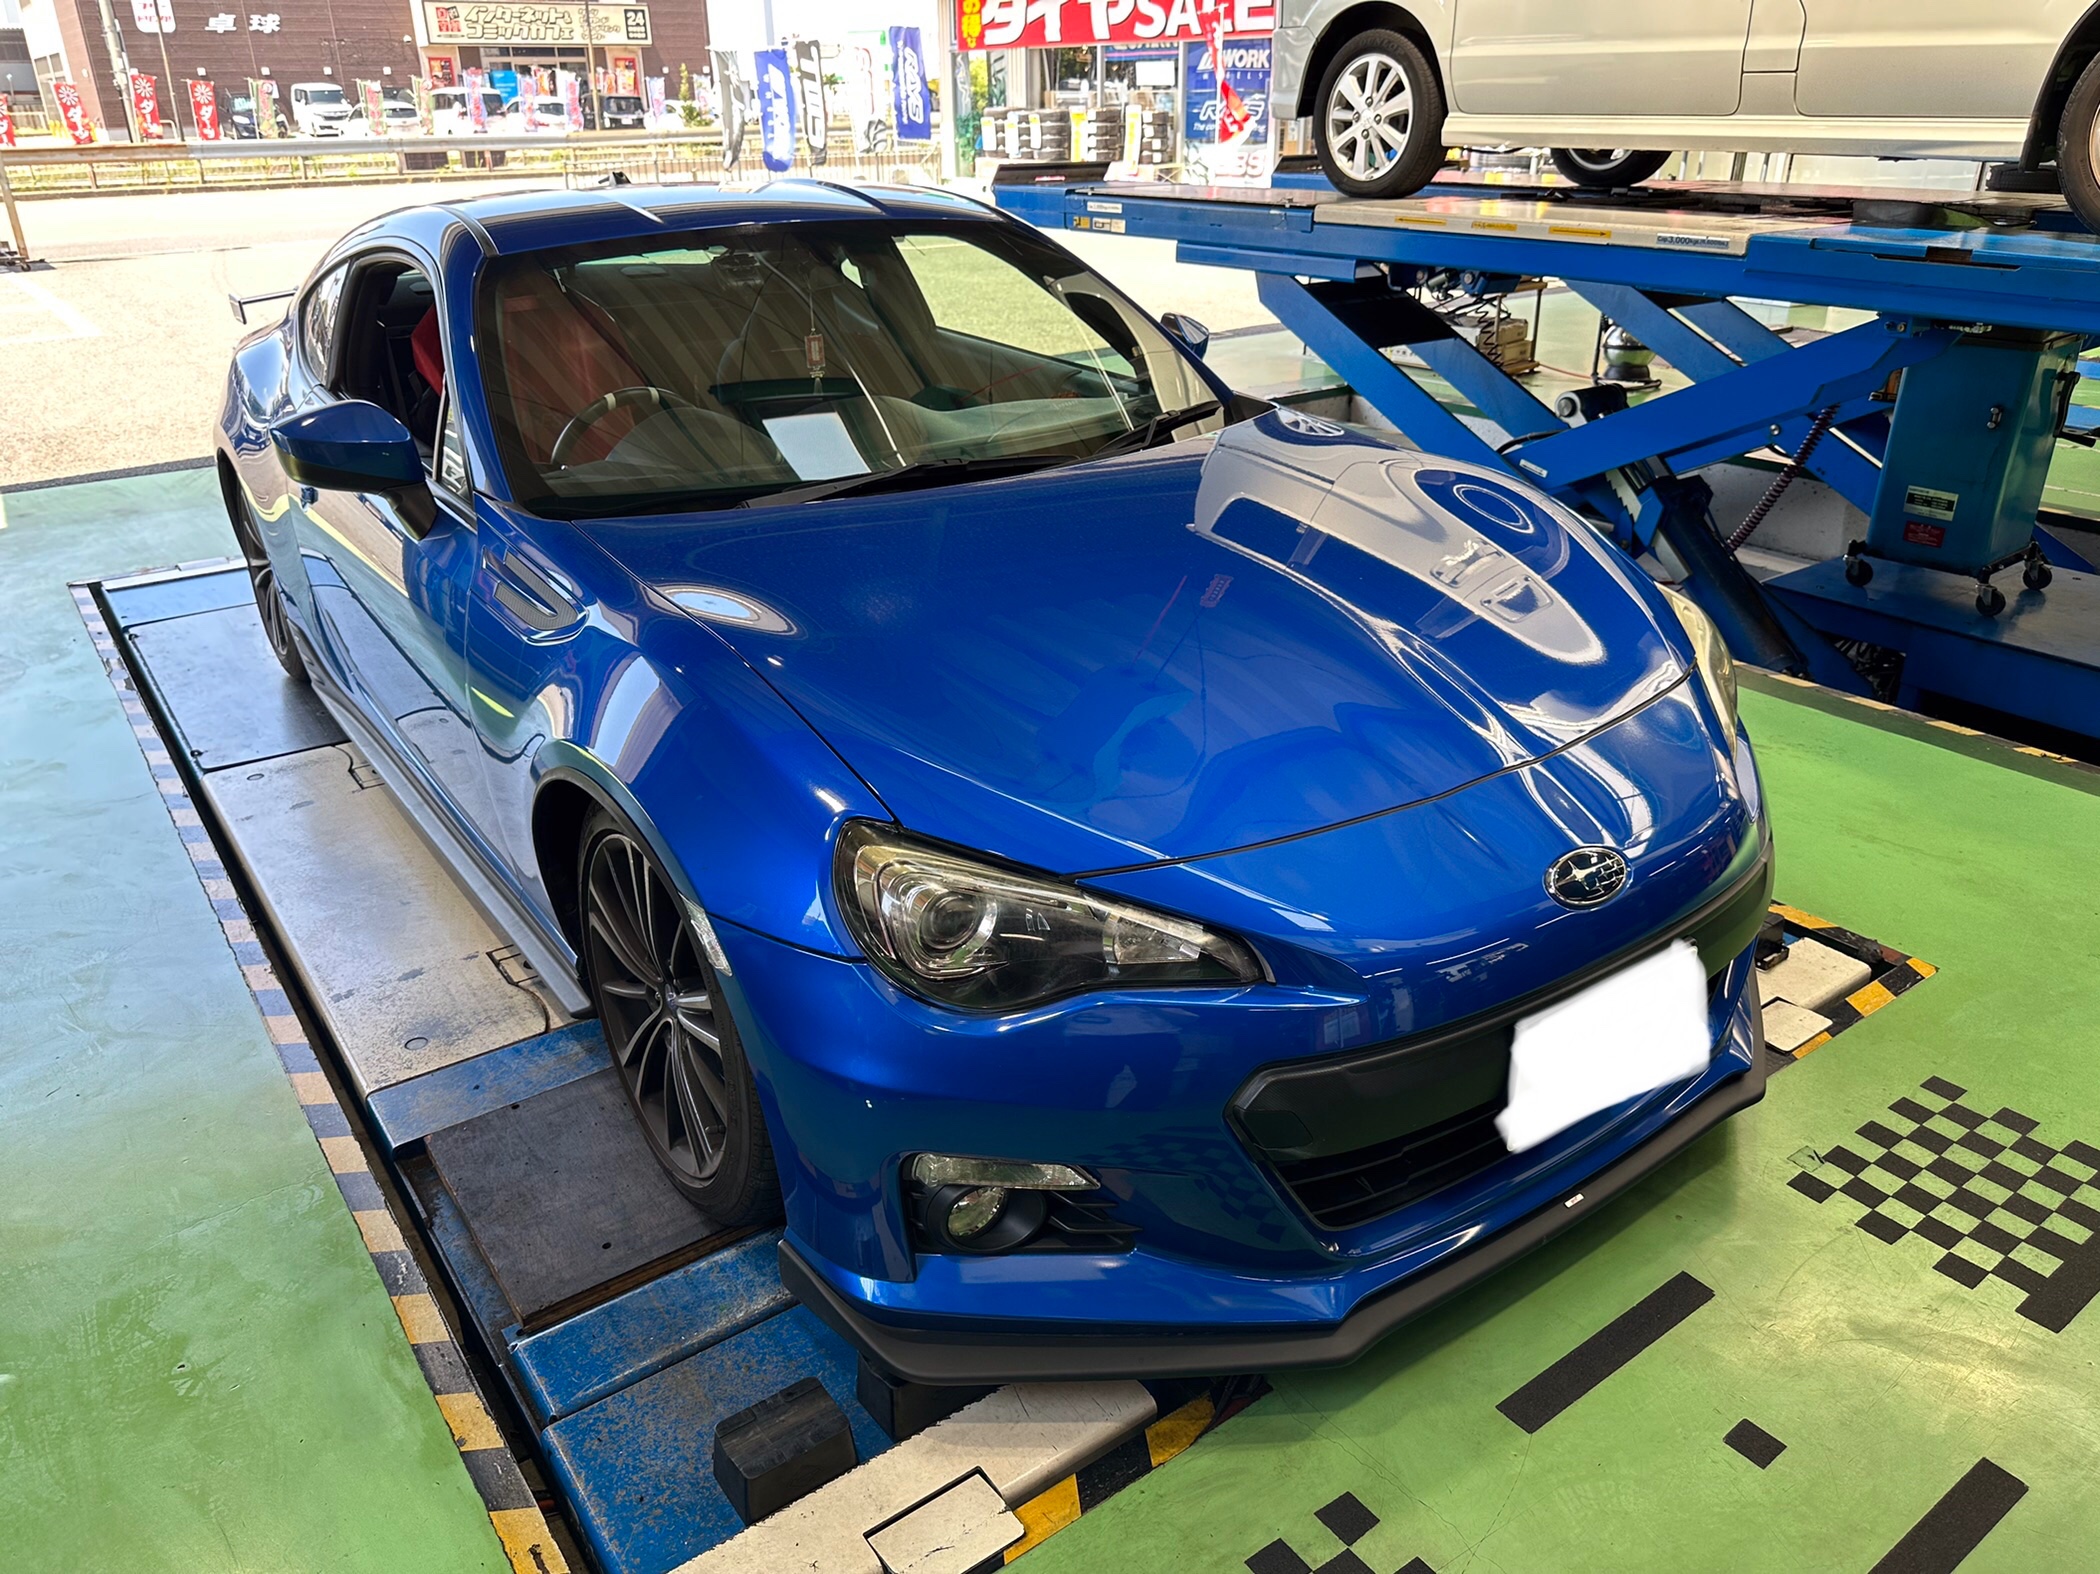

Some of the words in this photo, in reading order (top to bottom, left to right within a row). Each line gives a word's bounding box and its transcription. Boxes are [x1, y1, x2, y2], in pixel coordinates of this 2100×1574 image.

[204, 13, 281, 34] 卓球
[626, 11, 645, 26] 24
[1222, 48, 1271, 69] WORK
[1202, 71, 1264, 80] WEELS
